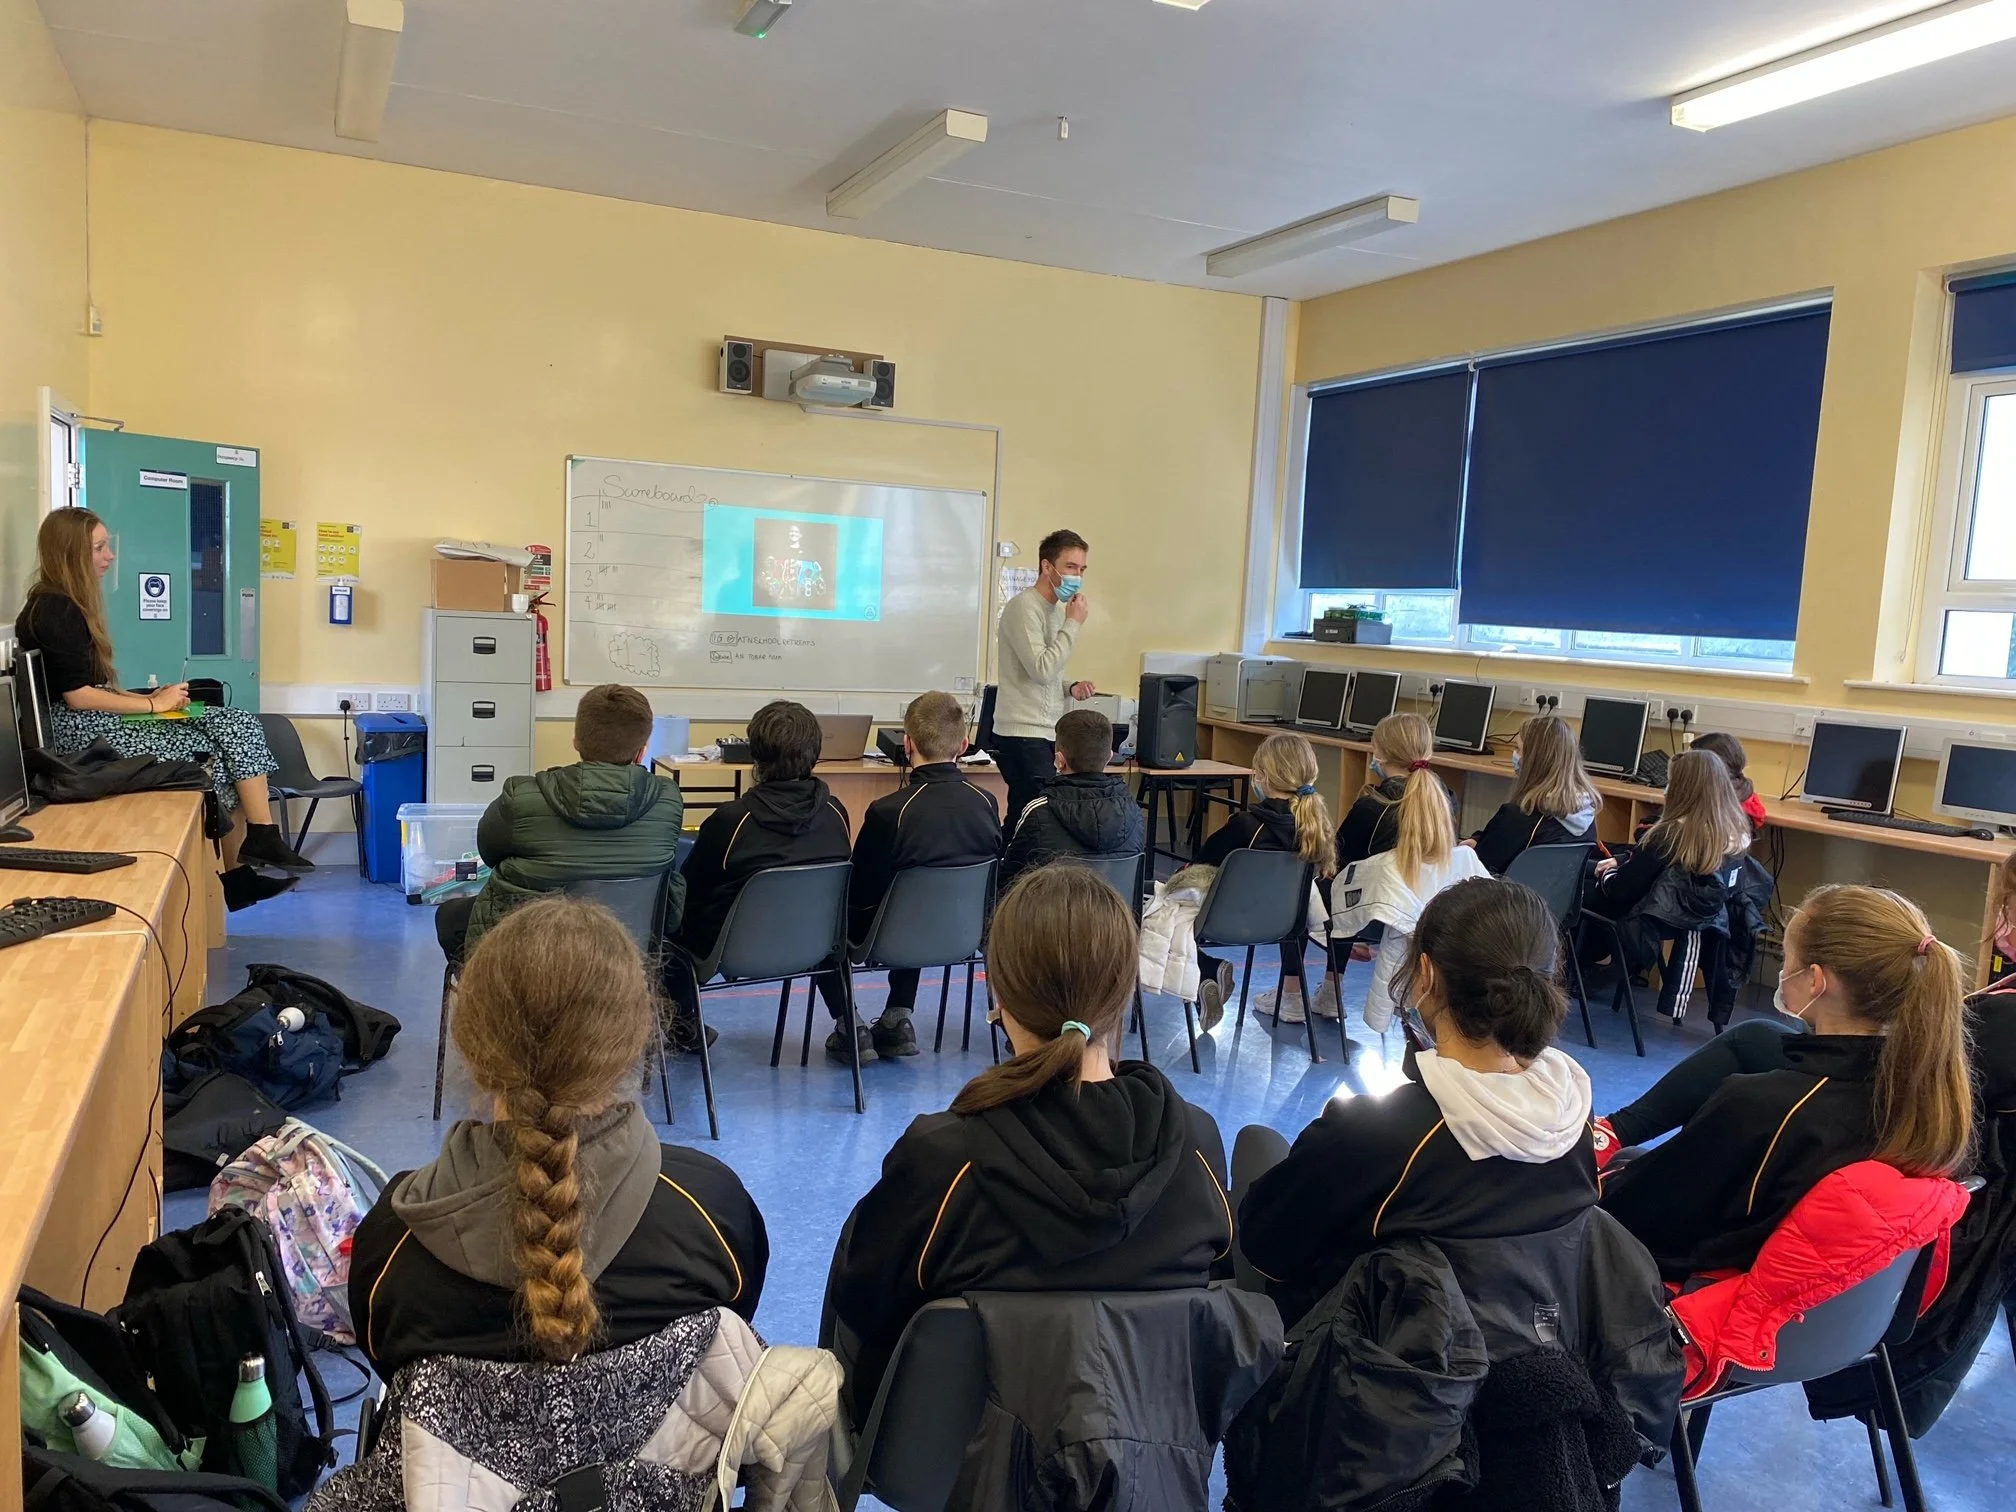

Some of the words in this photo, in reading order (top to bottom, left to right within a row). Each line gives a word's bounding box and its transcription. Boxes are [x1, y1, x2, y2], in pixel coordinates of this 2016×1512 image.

[143, 475, 168, 483] Computer
[584, 511, 598, 528] 1
[583, 541, 595, 560] 2
[584, 569, 594, 588] 3
